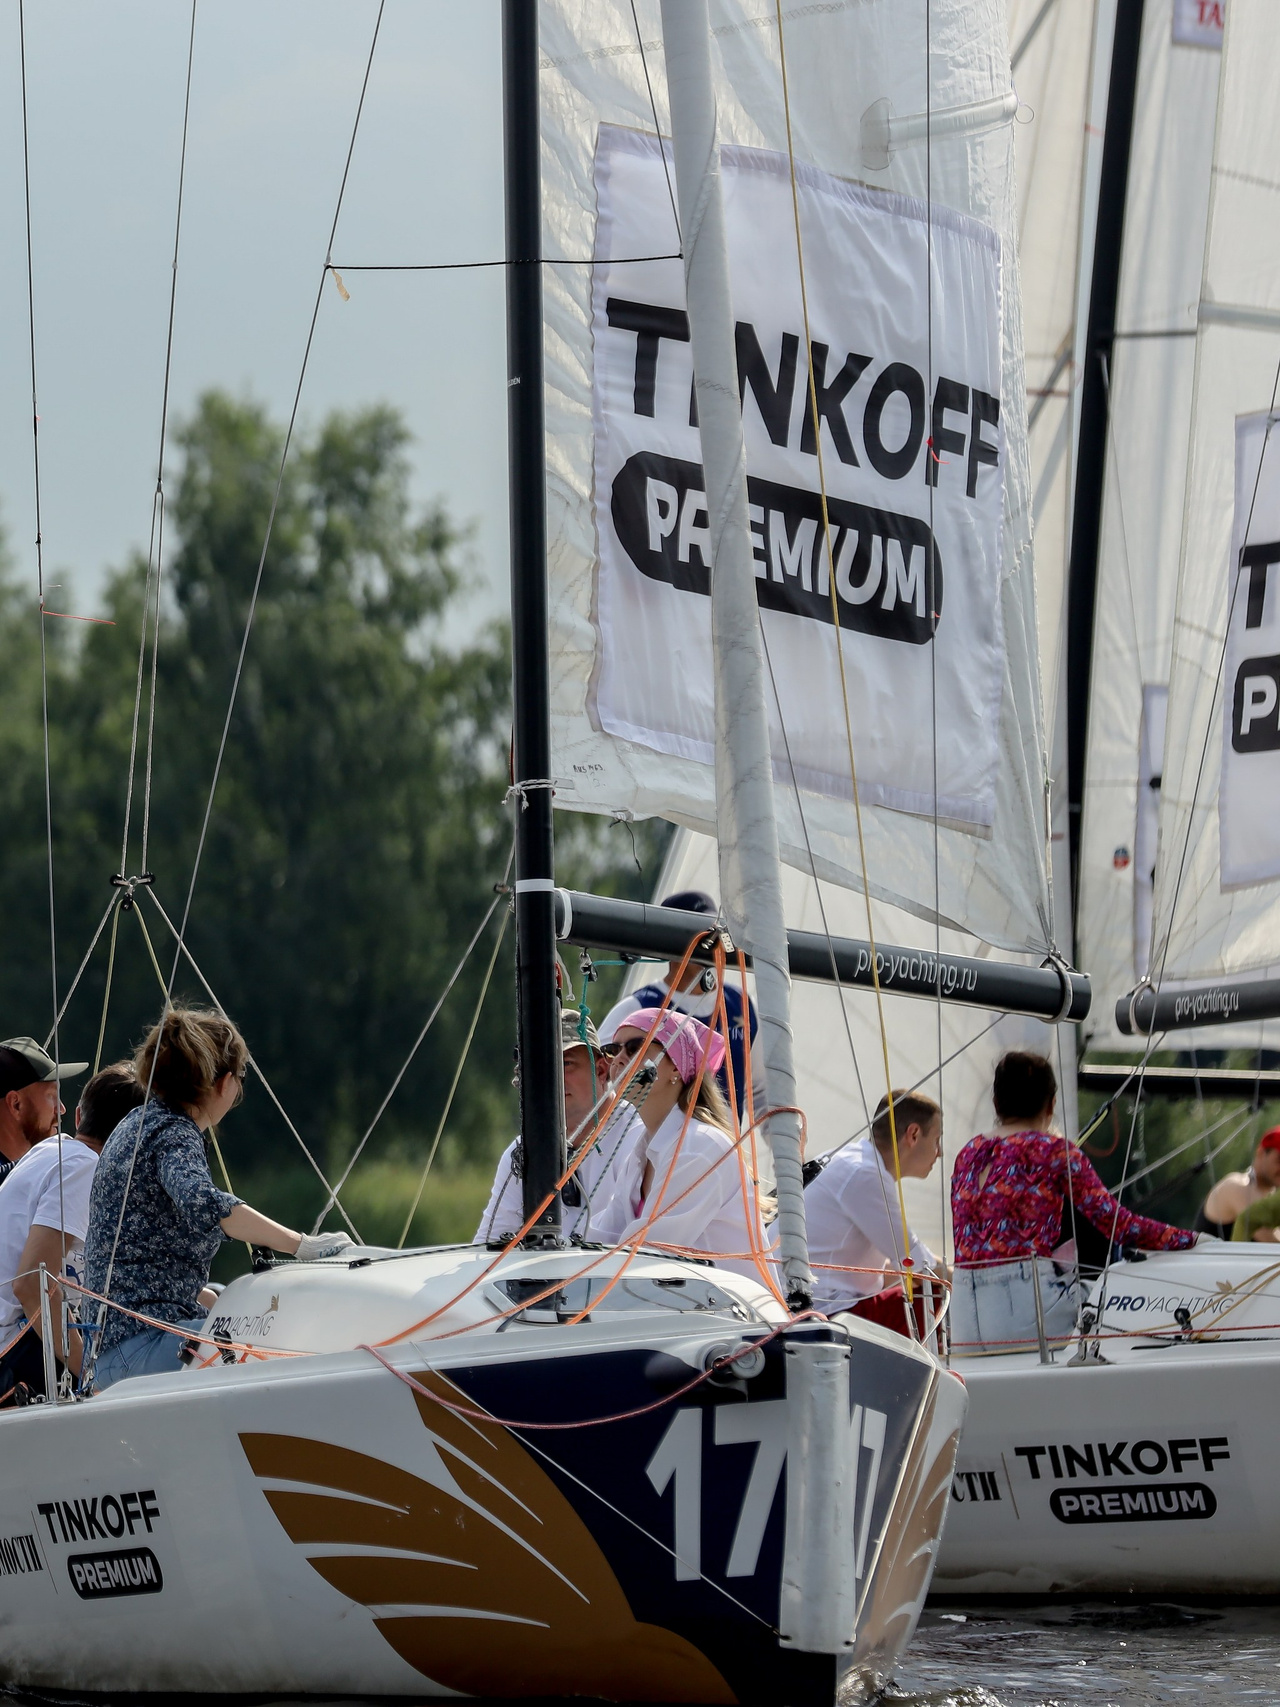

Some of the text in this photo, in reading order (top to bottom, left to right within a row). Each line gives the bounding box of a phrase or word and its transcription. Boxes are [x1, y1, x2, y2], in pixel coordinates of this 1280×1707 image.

[607, 296, 1001, 498] TNKOFF
[854, 947, 978, 995] pro-yachting.ru
[1175, 987, 1240, 1023] pro-yachting.ru
[1105, 1296, 1234, 1314] PROYACHTING
[1014, 1437, 1231, 1480] TINKOFF
[645, 1399, 787, 1582] 17
[1059, 1489, 1207, 1517] PREMIUM
[37, 1489, 161, 1544] TINKOFF
[71, 1554, 157, 1592] PREMIUM
